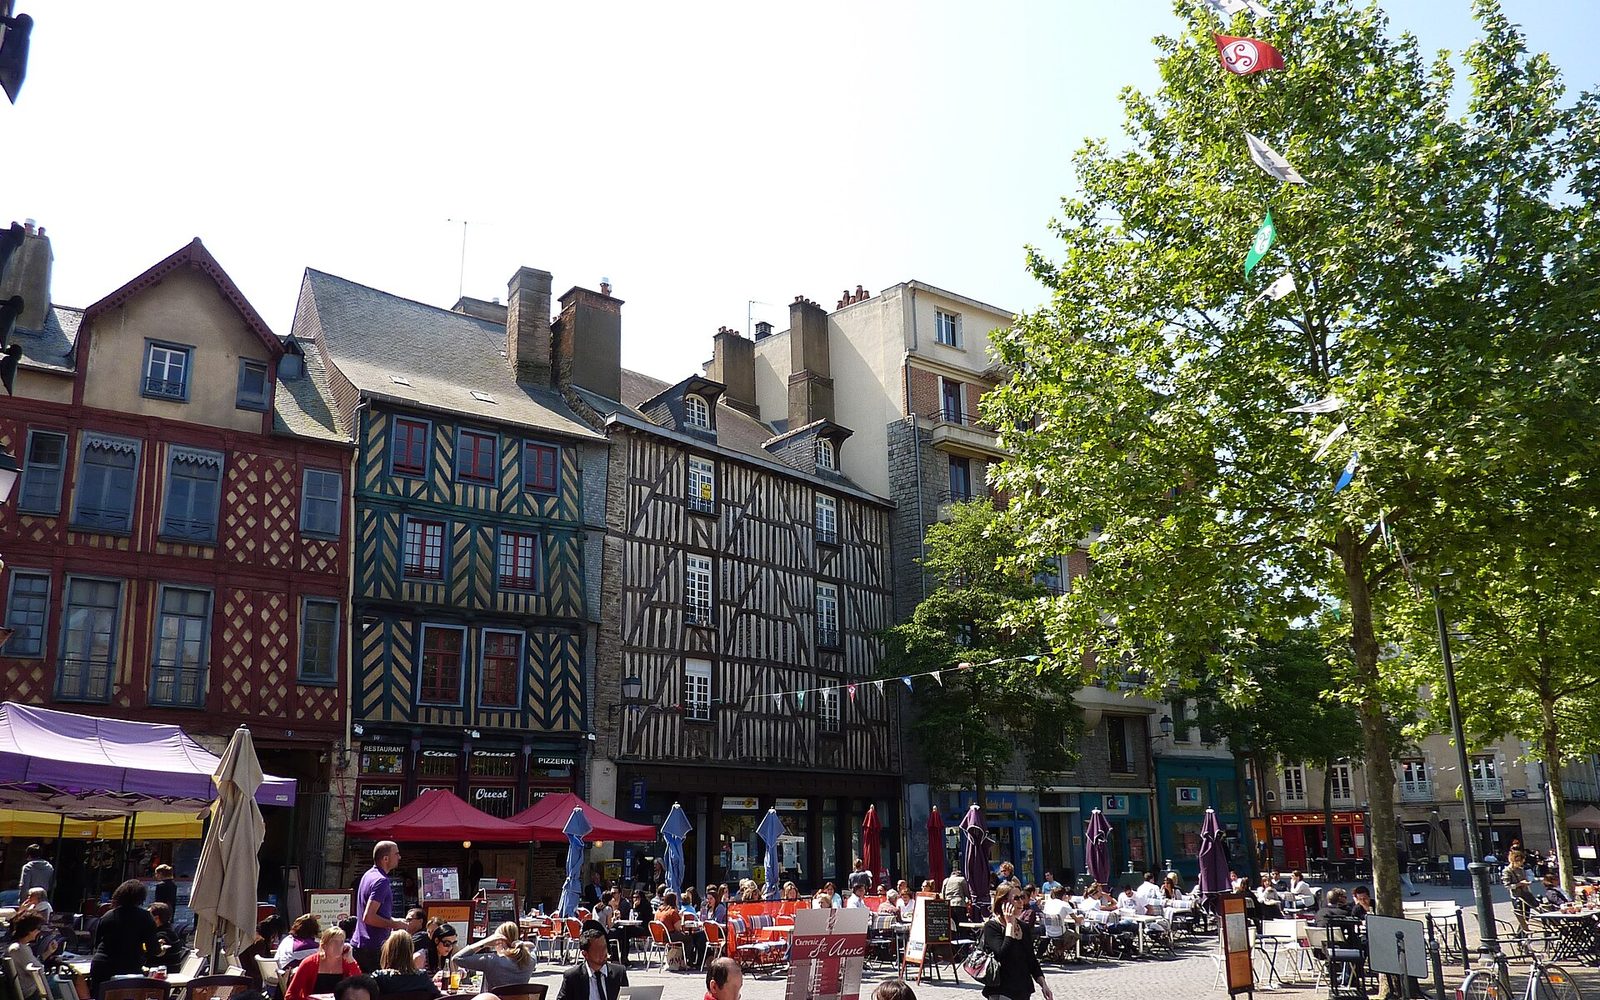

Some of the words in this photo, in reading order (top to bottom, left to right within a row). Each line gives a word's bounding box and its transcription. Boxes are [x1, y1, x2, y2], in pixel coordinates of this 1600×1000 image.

[363, 745, 405, 753] RESTAURANT
[473, 750, 516, 758] Ouest
[538, 757, 575, 765] PIZZERIA
[475, 788, 508, 800] Ouest
[828, 937, 864, 957] Anne
